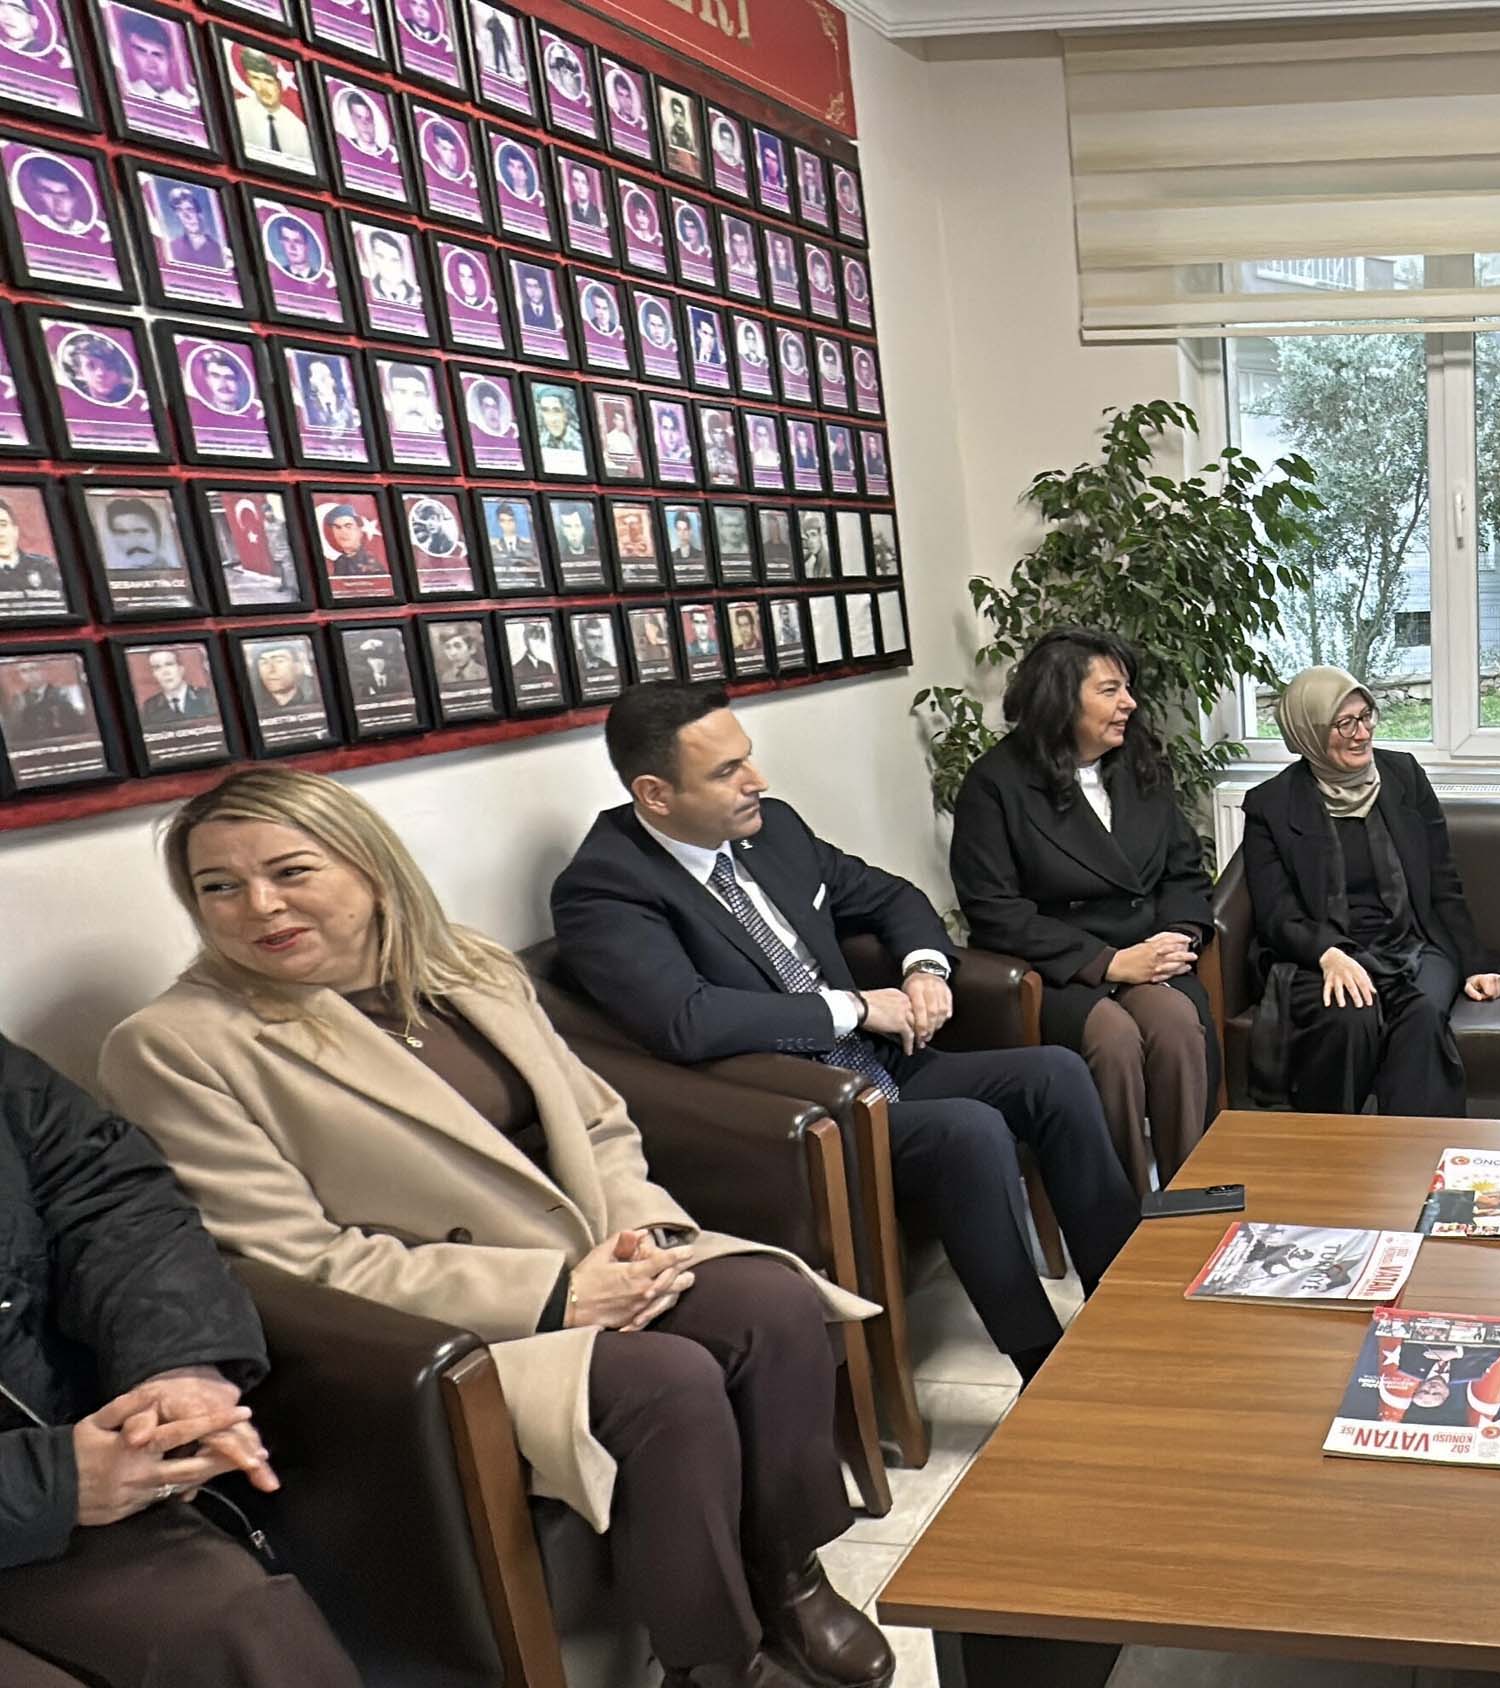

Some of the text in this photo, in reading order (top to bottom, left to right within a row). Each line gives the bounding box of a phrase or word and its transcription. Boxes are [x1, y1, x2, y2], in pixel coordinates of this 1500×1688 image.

[1379, 1265, 1404, 1292] VATAN
[1353, 1427, 1429, 1452] VATAN
[1432, 1432, 1473, 1444] KONUSU
